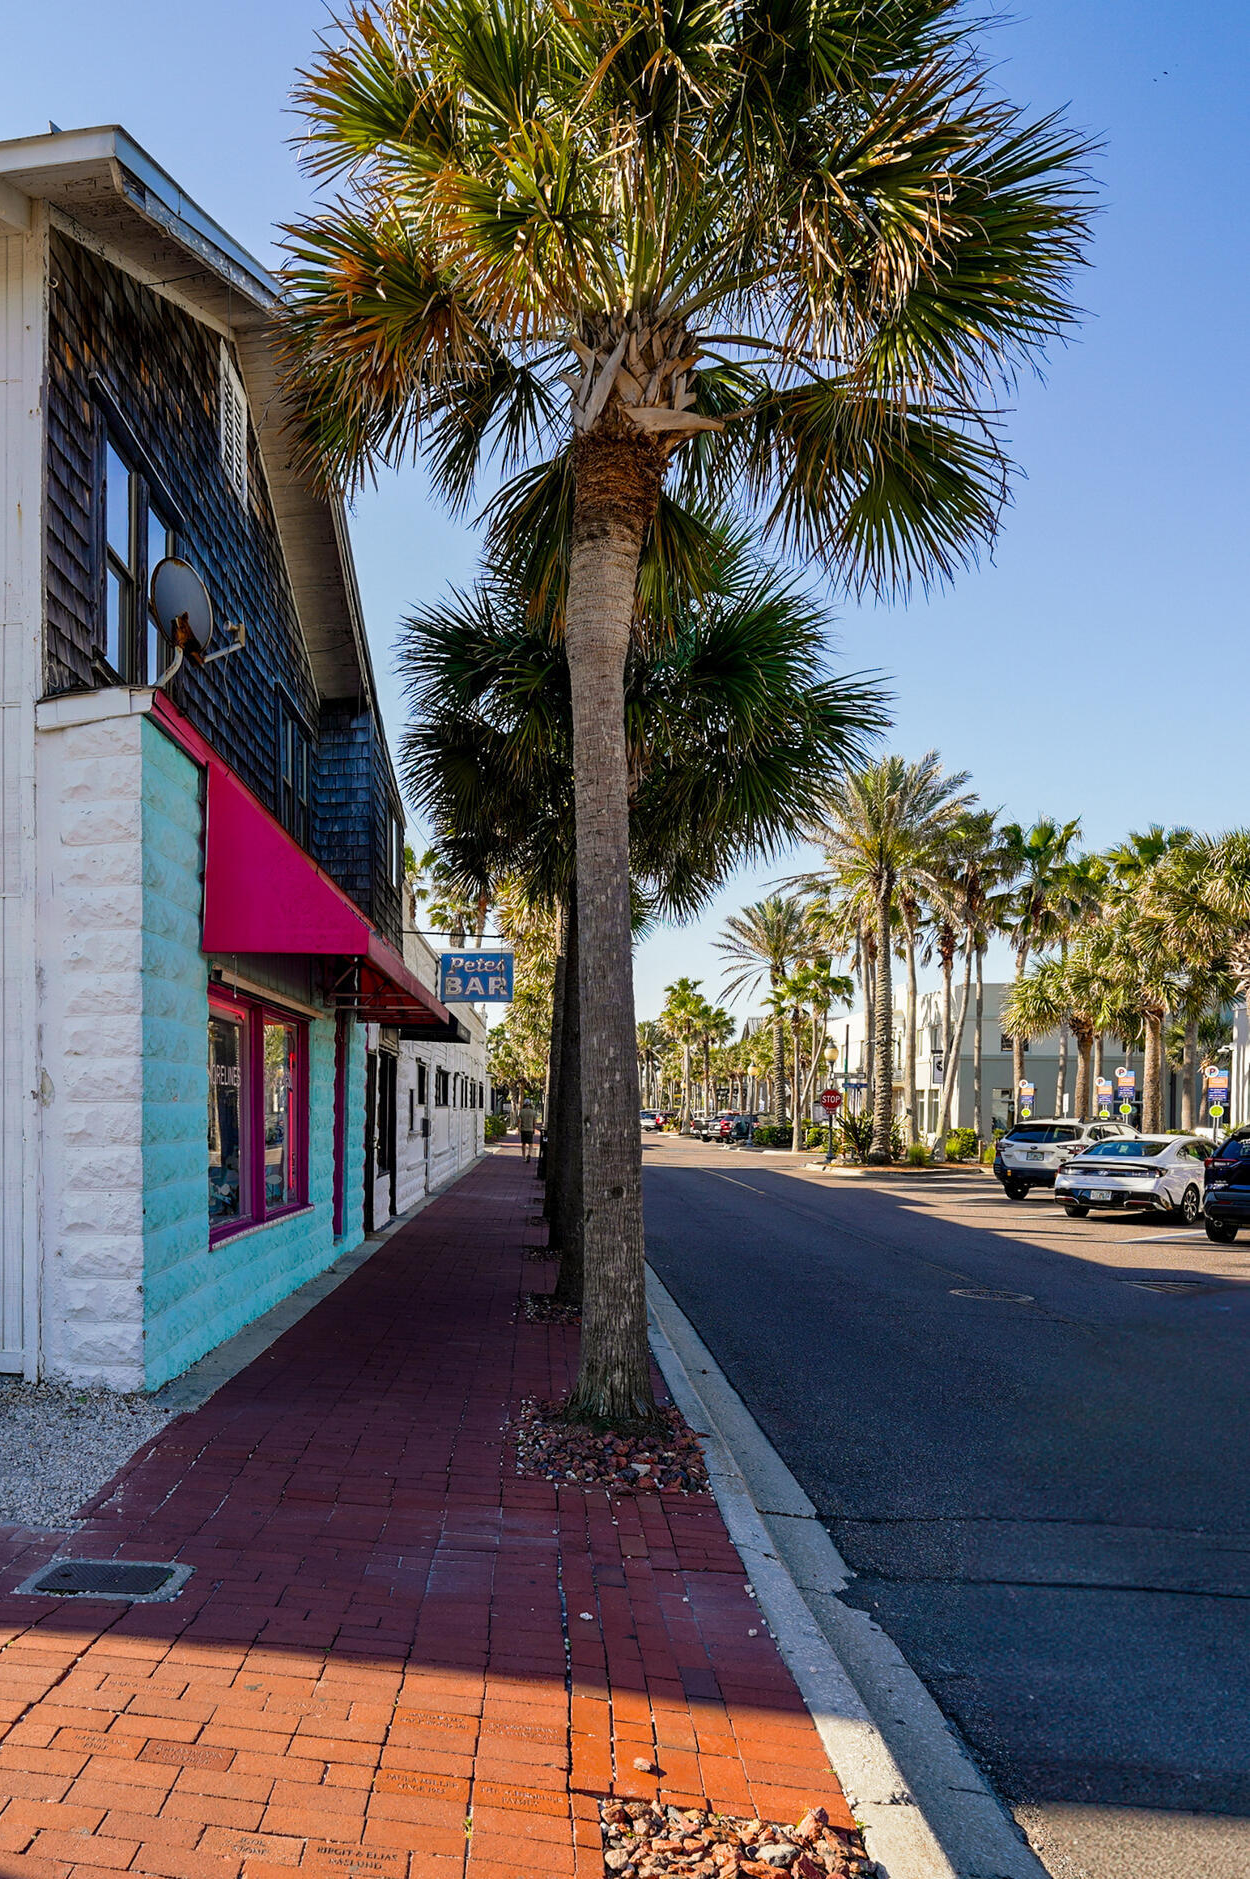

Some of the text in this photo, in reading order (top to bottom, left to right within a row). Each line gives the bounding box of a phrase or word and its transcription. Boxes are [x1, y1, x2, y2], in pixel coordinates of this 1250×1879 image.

[447, 957, 504, 974] Petes
[445, 976, 508, 995] BAR
[822, 1095, 841, 1104] STOP
